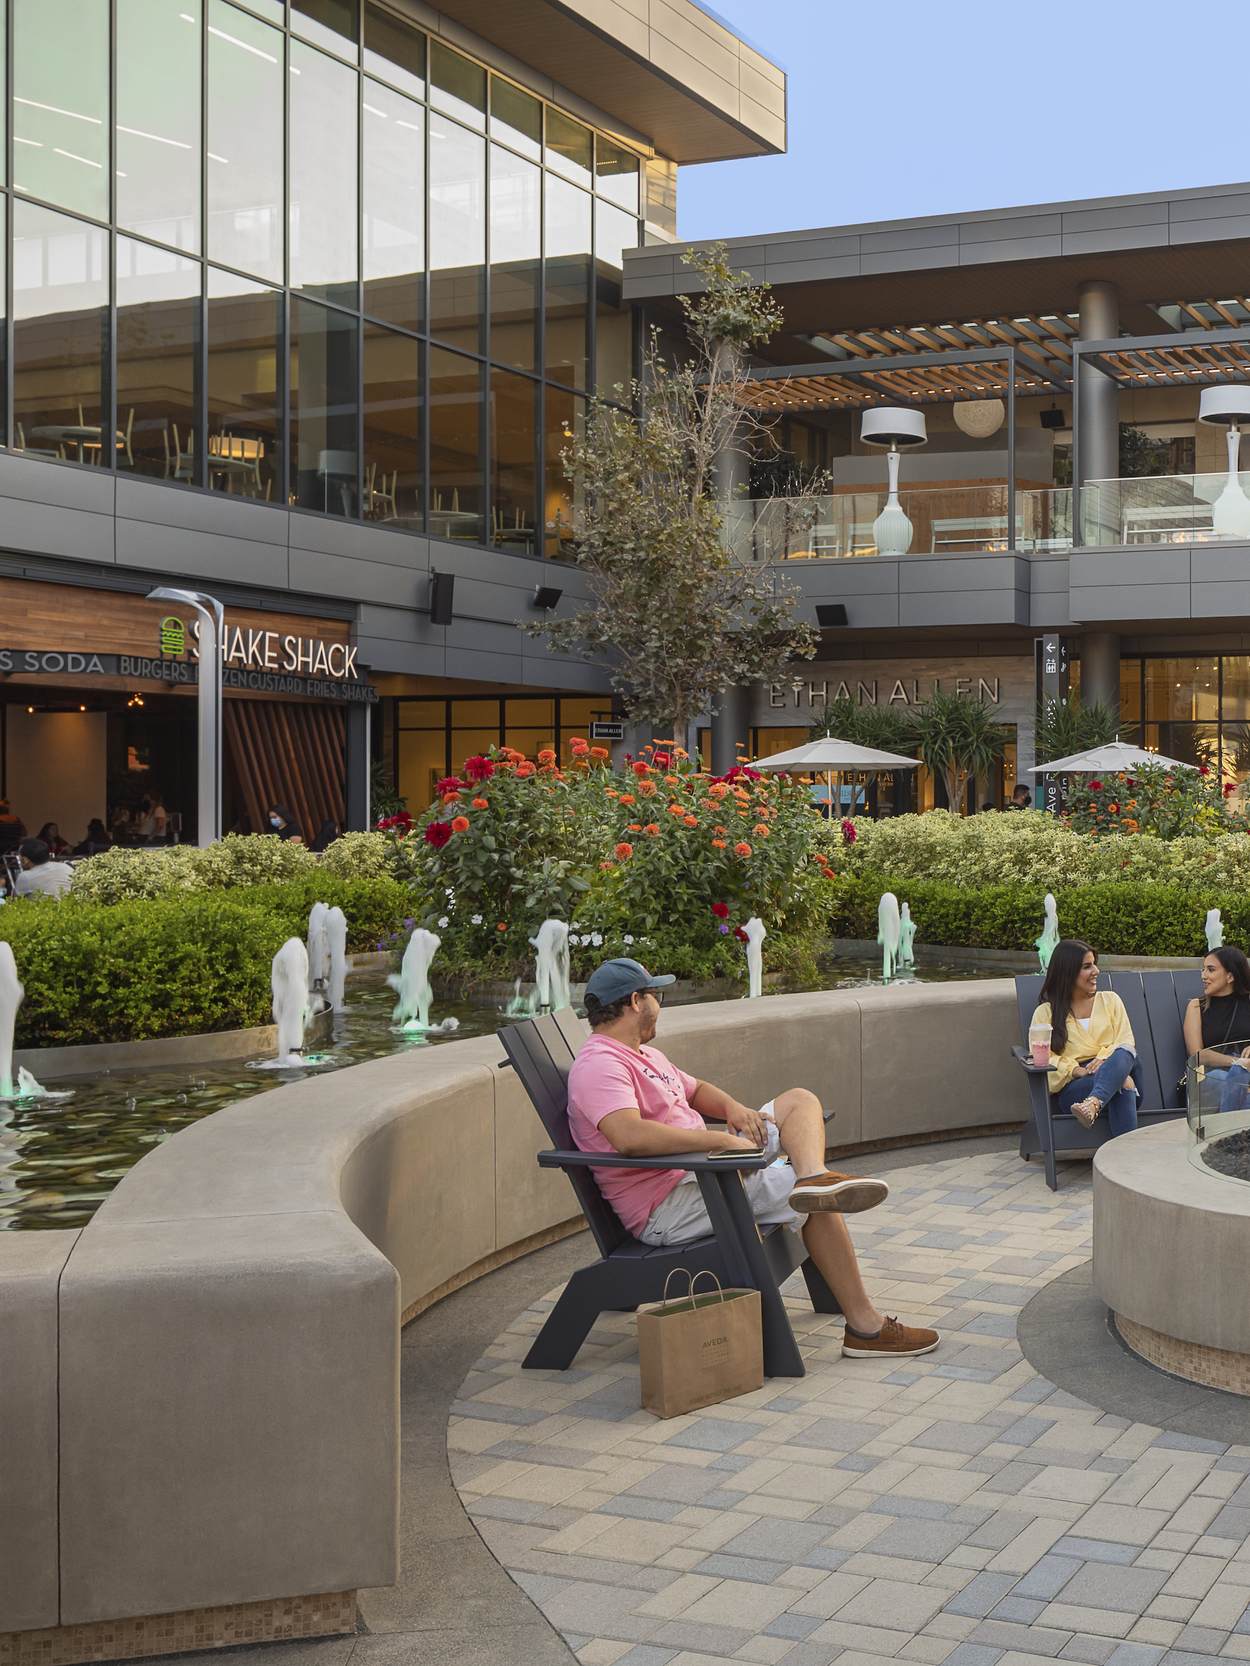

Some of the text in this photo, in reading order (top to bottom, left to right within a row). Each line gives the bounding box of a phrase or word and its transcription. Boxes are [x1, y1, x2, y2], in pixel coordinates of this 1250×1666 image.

[24, 651, 105, 674] SODA
[283, 635, 358, 679] SHACK
[120, 655, 380, 702] BURGERS FZEN CUSTARD FRIES SHAKES
[769, 680, 878, 708] ETHAN
[1046, 787, 1057, 812] Ave
[702, 1336, 728, 1349] AVEDA
